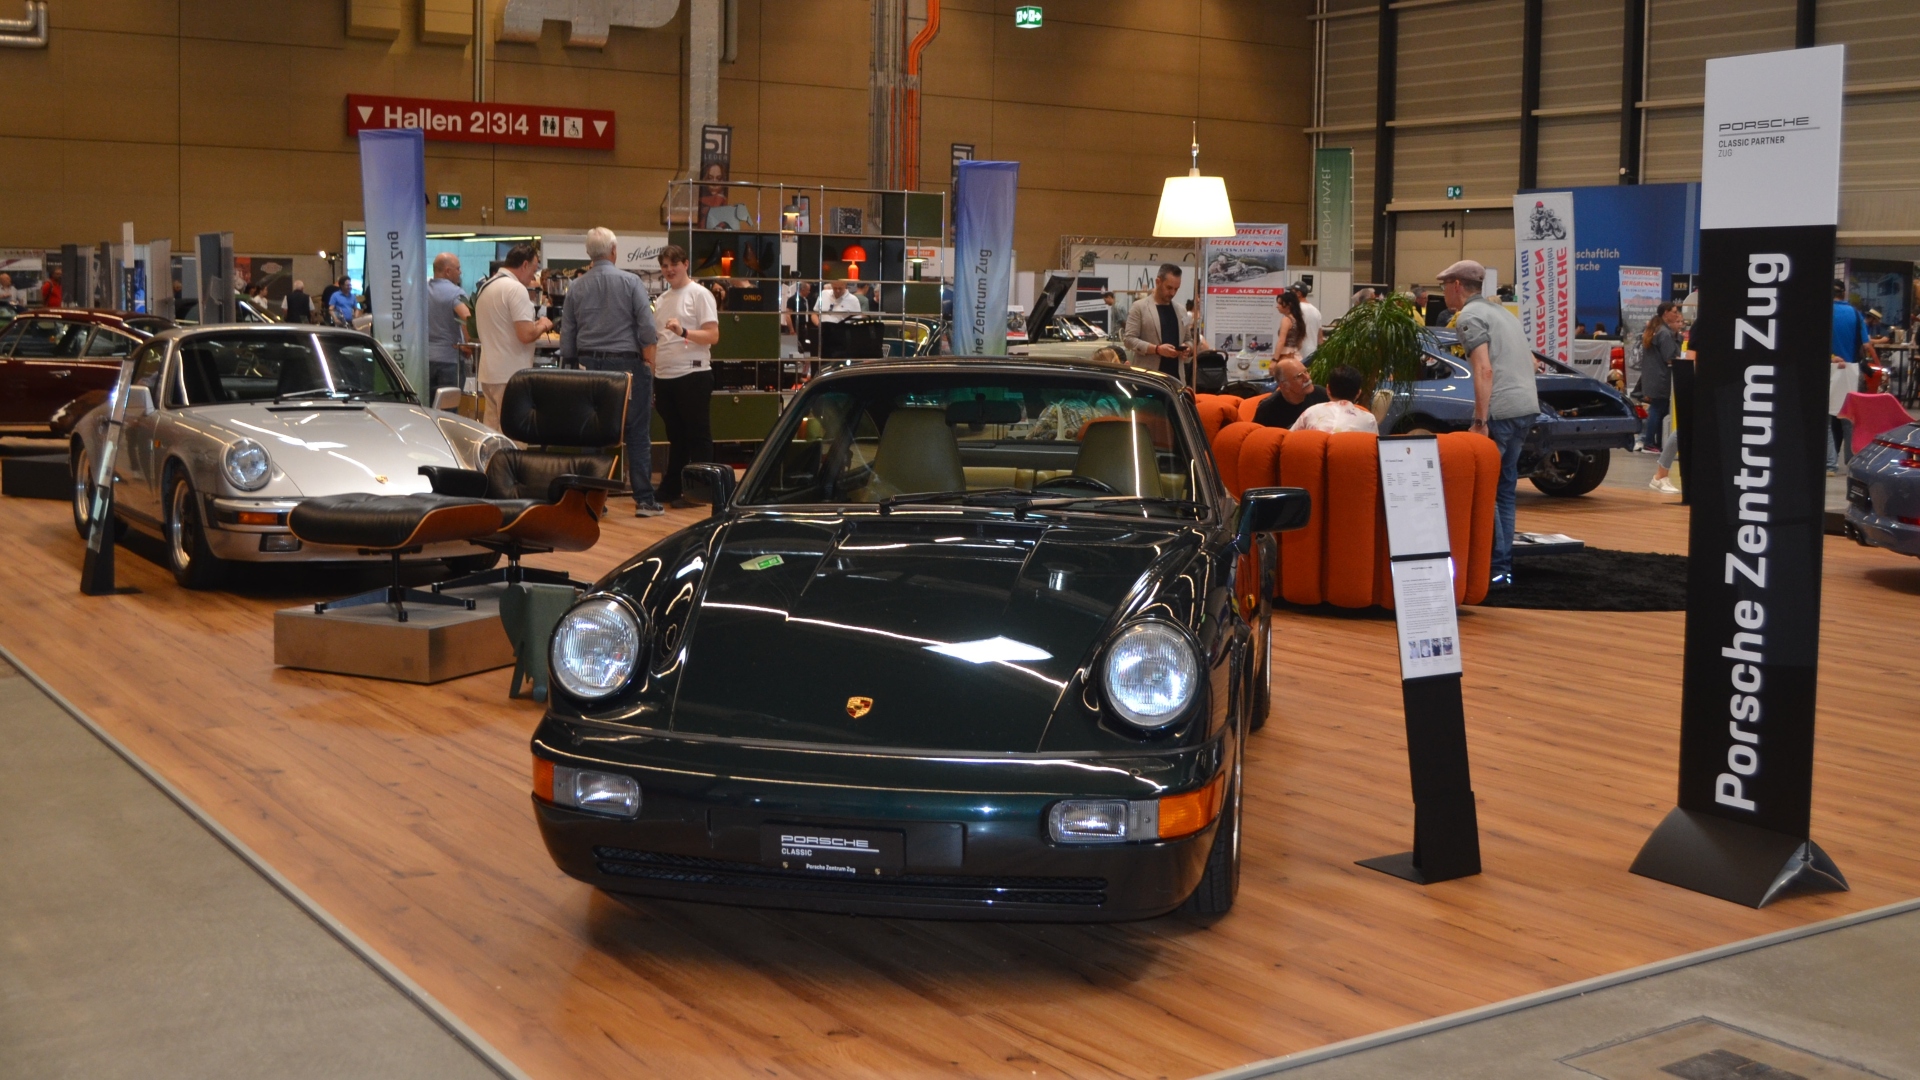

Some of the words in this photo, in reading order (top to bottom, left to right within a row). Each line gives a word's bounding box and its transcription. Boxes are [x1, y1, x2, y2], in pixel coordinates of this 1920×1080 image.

[384, 105, 462, 133] Hallen
[1719, 116, 1810, 132] PORSCHE
[1718, 138, 1749, 148] CLASSIC
[1750, 135, 1785, 146] PARTNER
[1718, 149, 1733, 158] ZUG
[1442, 220, 1456, 238] 11
[1210, 239, 1283, 247] BERGRENNEN
[627, 245, 664, 262] Ackerm
[975, 248, 992, 274] Zug
[1575, 247, 1620, 259] schaftlich
[1575, 260, 1600, 271] rsche
[972, 278, 987, 335] Zentrum
[1734, 252, 1791, 350] Zug
[1724, 365, 1775, 588] Zentrum
[1715, 600, 1766, 812] Porsche
[781, 834, 869, 848] PORSCHE
[781, 848, 813, 857] CLASSIC
